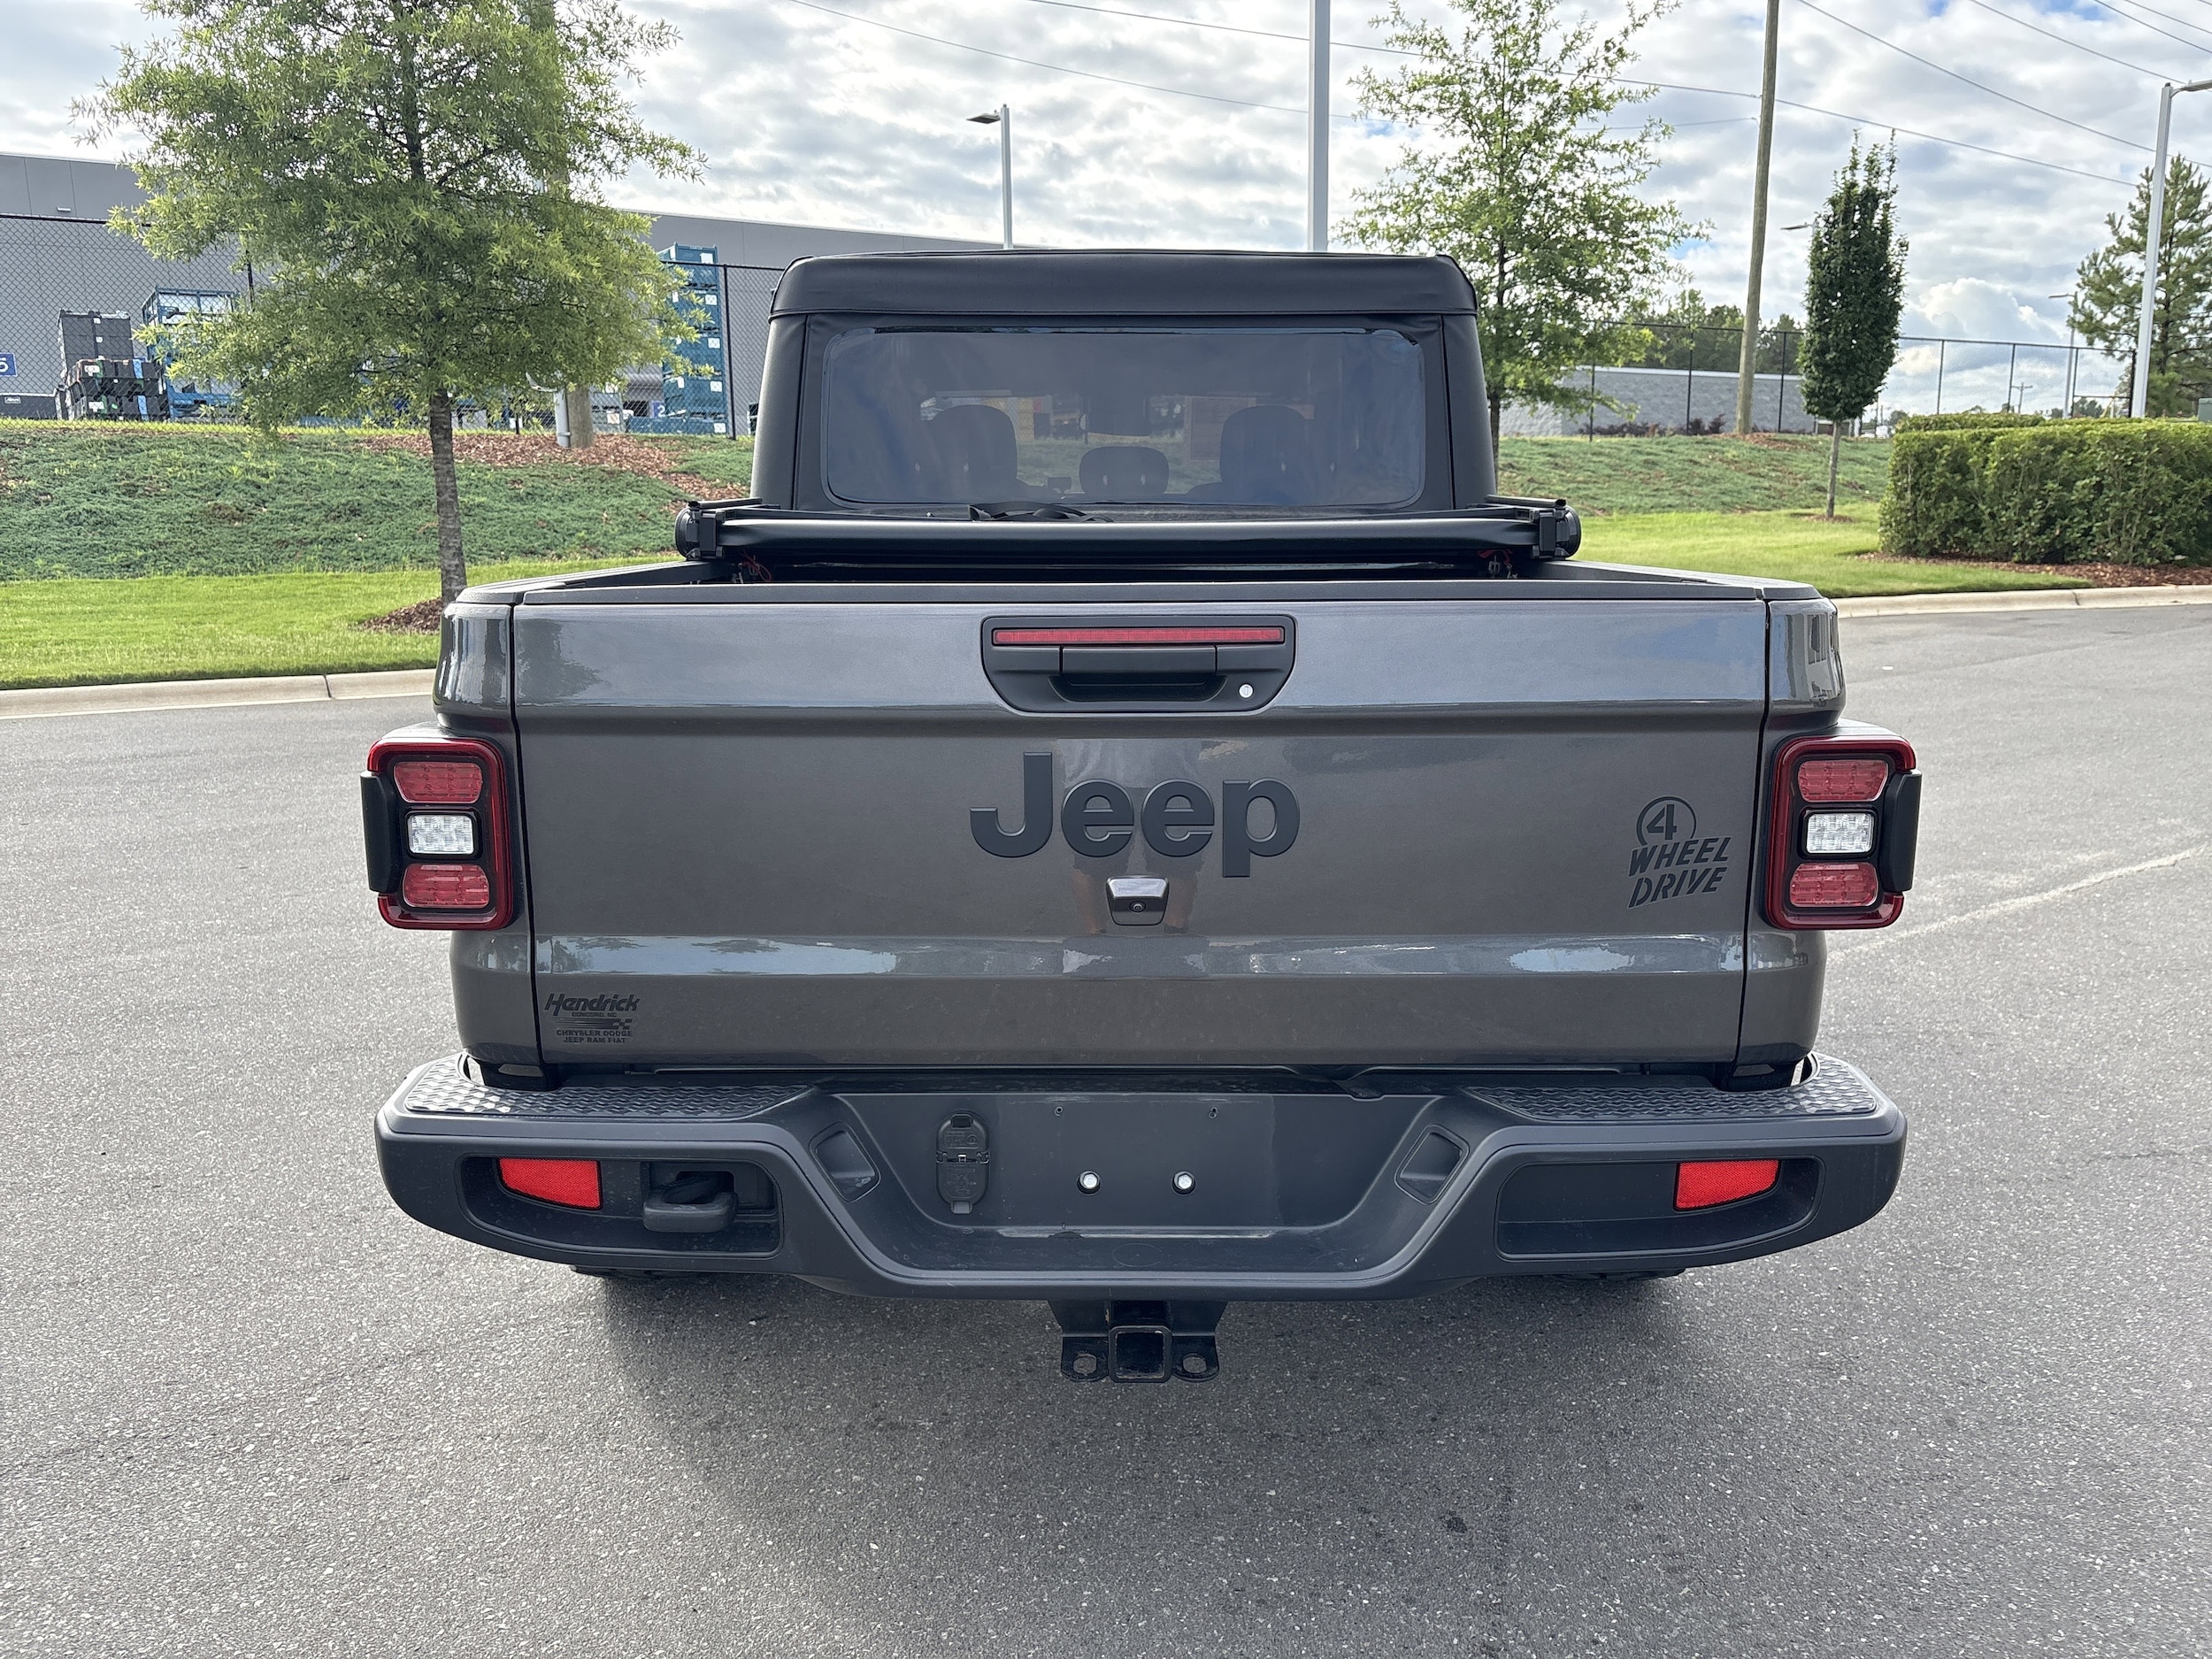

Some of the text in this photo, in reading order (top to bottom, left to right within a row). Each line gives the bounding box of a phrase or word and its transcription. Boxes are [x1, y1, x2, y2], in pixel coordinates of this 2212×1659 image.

[657, 404, 665, 418] 2
[970, 751, 1301, 878] Jeep
[1646, 803, 1678, 841] 4
[1629, 837, 1732, 877] WHEEL
[1628, 867, 1728, 909] DRIVE
[544, 993, 641, 1017] Hendrick
